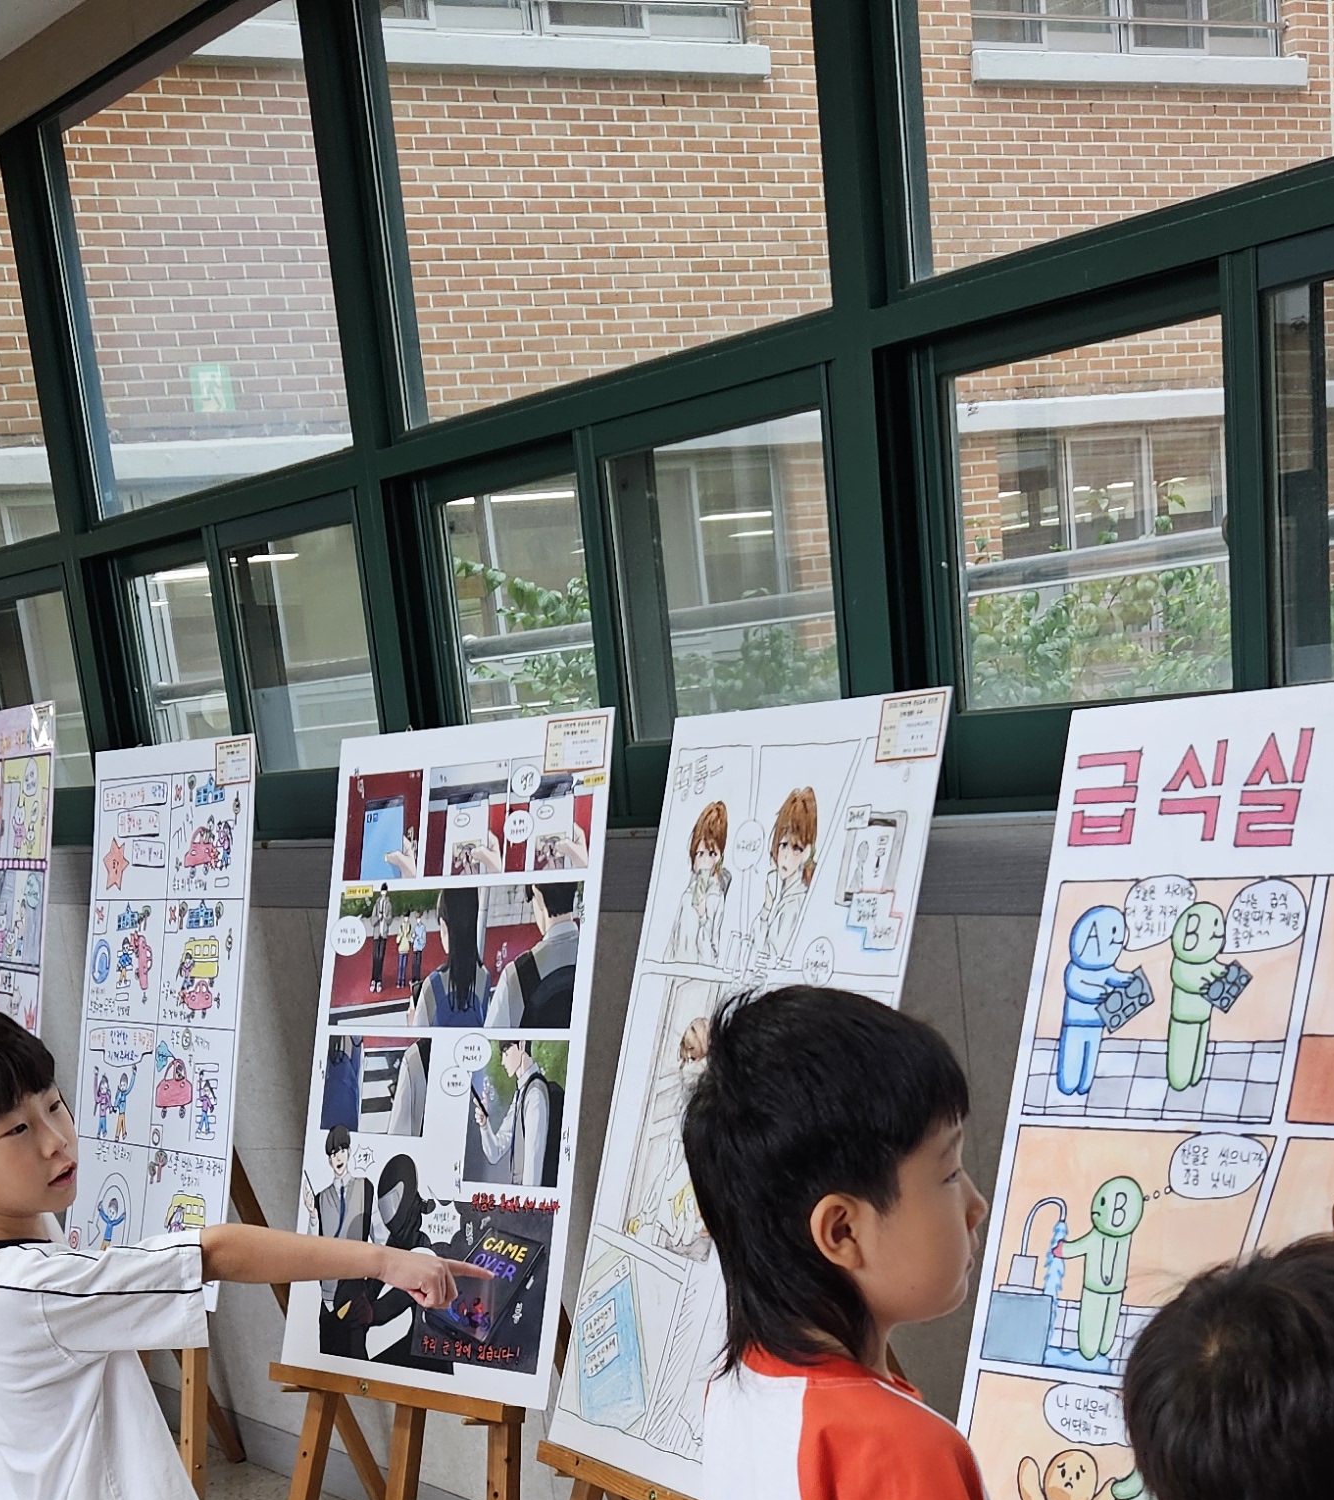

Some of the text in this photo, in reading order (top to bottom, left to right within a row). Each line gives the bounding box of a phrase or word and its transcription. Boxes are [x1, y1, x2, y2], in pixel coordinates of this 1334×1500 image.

[1067, 726, 1316, 847] 급식실
[1238, 892, 1258, 909] 나는
[1079, 921, 1102, 957] A
[1182, 913, 1201, 951] B
[1111, 1192, 1128, 1227] B
[483, 1237, 528, 1263] GAME
[473, 1253, 517, 1282] OVER
[1056, 1394, 1069, 1409] 나
